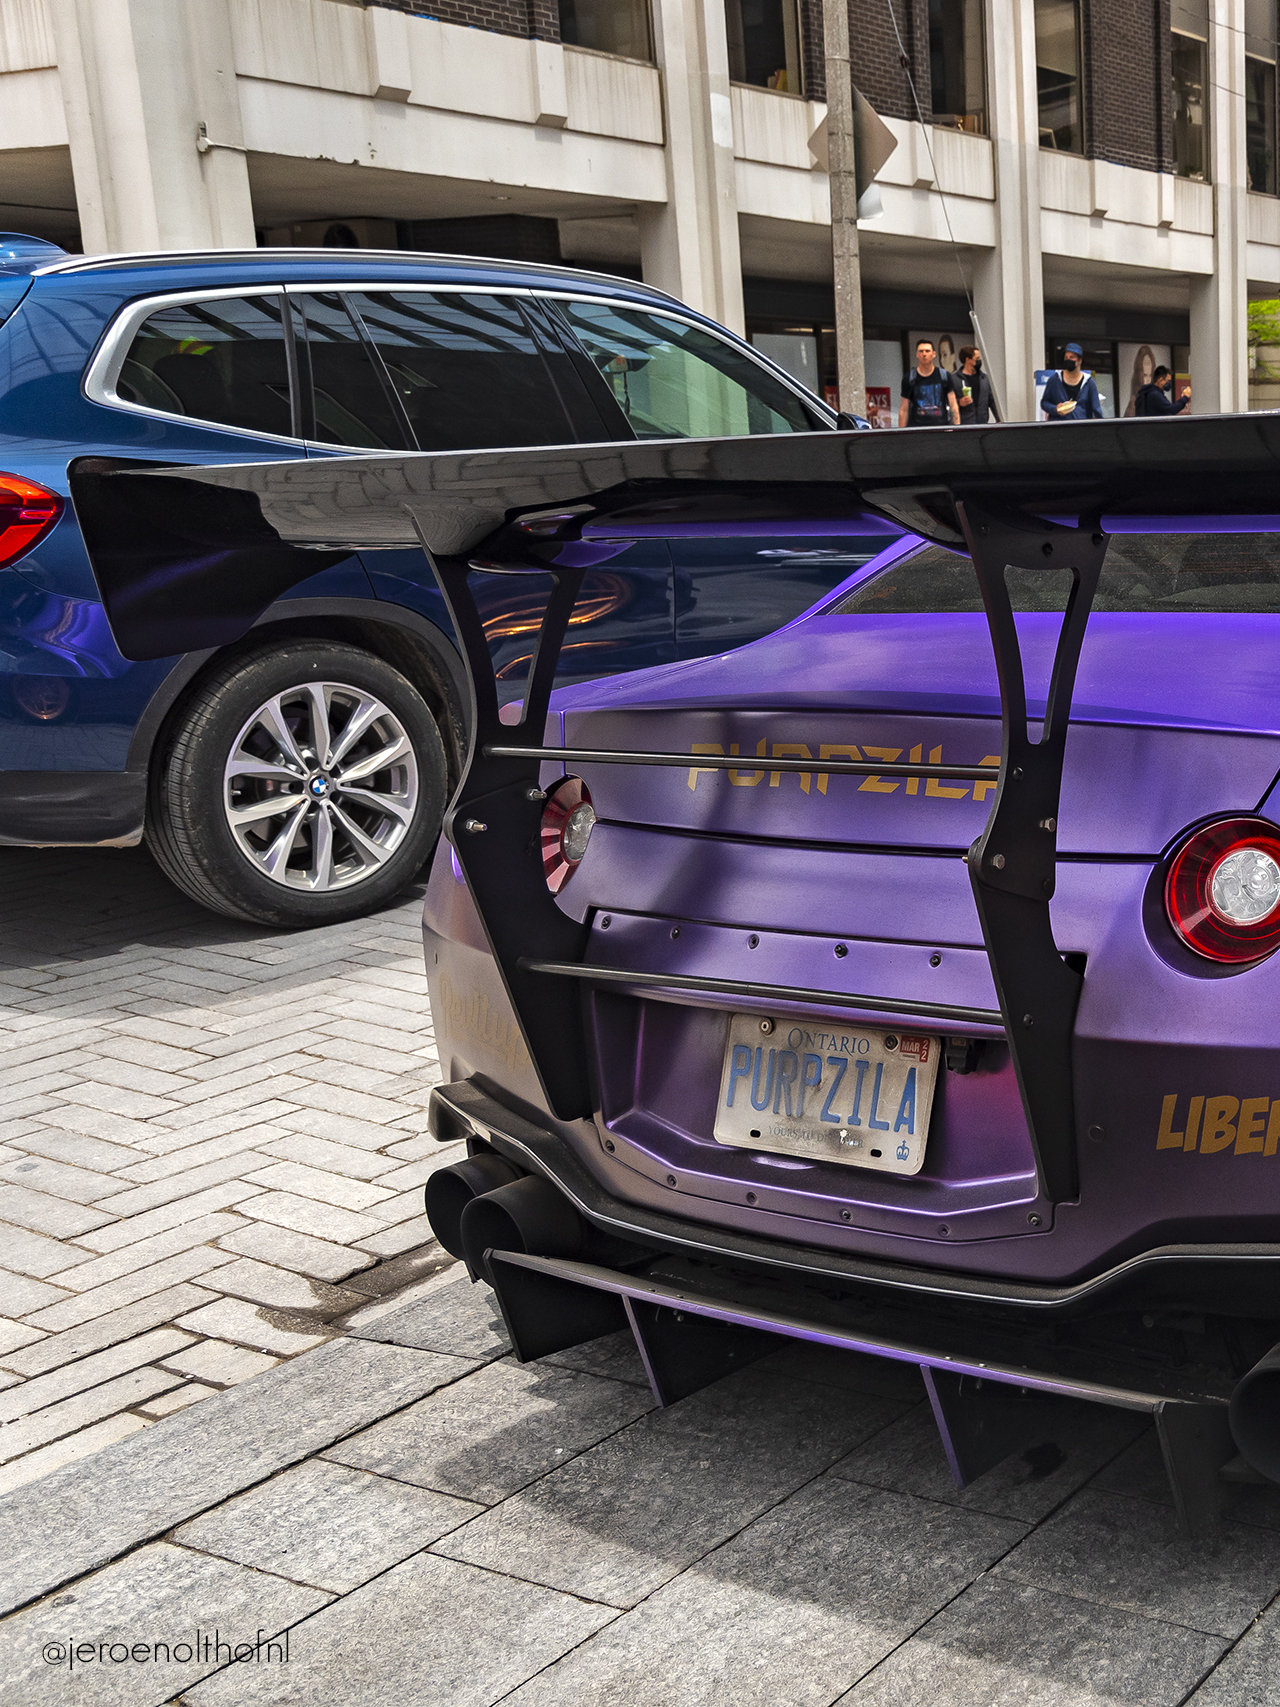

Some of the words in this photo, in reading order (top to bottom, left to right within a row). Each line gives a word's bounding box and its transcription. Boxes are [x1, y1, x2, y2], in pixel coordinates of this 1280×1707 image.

[787, 1027, 871, 1057] ONTARIO
[901, 1041, 921, 1053] MAR
[726, 1044, 917, 1136] PURPZILA
[768, 1125, 799, 1138] YOURS
[801, 1130, 815, 1142] TO
